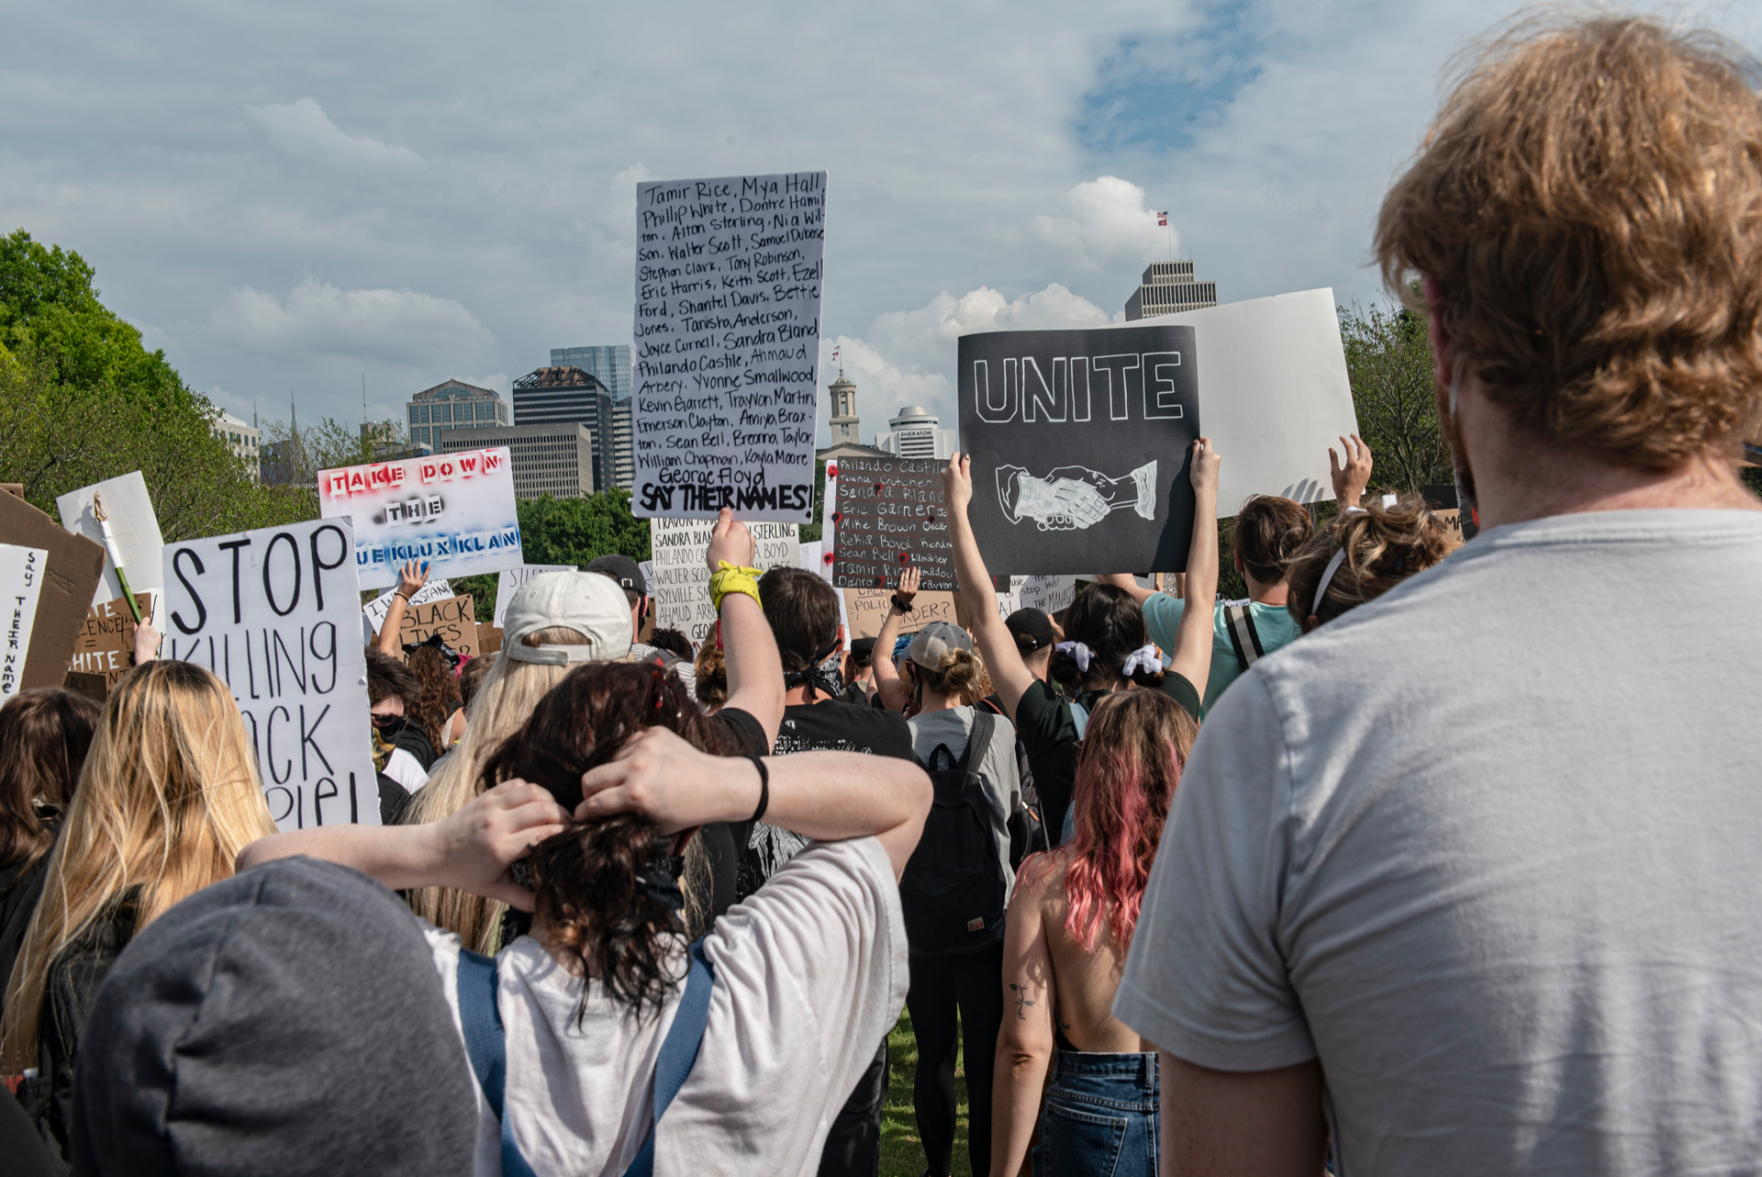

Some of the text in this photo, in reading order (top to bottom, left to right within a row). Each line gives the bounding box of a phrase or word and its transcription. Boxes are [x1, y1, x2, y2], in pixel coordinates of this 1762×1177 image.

[645, 173, 825, 206] Tamir Rice, Mya Hall,
[642, 205, 687, 228] Phillip
[690, 200, 735, 218] White,
[739, 198, 785, 213] Dontre
[672, 224, 706, 241] Alton
[773, 214, 799, 228] Nia
[804, 208, 825, 224] Wil-
[668, 242, 705, 260] Walter
[709, 234, 749, 255] Scott,
[751, 233, 789, 249] Samuel
[685, 261, 721, 276] Clark,
[726, 255, 750, 273] Tony
[753, 249, 805, 267] Robinson,
[641, 259, 823, 300] Eric Harris, Keith Scott, Ezell
[639, 302, 674, 318] Ford,
[679, 295, 727, 315] Shantel
[773, 285, 820, 302] Bettie
[681, 315, 733, 333] Tanisha
[733, 309, 797, 329] Anderson,
[639, 318, 819, 358] Joyce Curnell, Sandra Bland,
[639, 344, 807, 377] Philando Castile, Ahmaud
[693, 373, 742, 391] Yvonne
[743, 366, 817, 386] Smallwood,
[974, 351, 1183, 423] UNITE
[639, 386, 817, 413] Kevin Garrett, Trayvon Martin,
[637, 417, 687, 434] Emerson
[666, 435, 698, 449] Sean
[702, 432, 729, 448] Bell,
[780, 427, 814, 448] Taylor,
[638, 448, 808, 469] William Chapman, Kayla Moore
[840, 460, 893, 472] Philando
[332, 455, 499, 490] TAKE DOWN
[659, 467, 765, 488] George Floyd
[388, 500, 441, 521] THE
[639, 483, 813, 518] SAY THEIR NAMES!
[843, 501, 935, 517] Eric Garner
[754, 522, 795, 540] STERLING
[841, 517, 916, 532] Mike Brown
[922, 522, 948, 531] Oscar
[356, 531, 518, 565] UE KLUX KLAN
[655, 532, 691, 547] SANDRA
[764, 542, 788, 558] BOYD
[655, 548, 694, 566] PHILANDO
[839, 547, 894, 562] Sean Bell
[170, 524, 347, 636] STOP
[655, 568, 689, 585] WALTER
[838, 562, 905, 576] Tamir Ric
[920, 566, 952, 578] madou
[658, 586, 694, 604] SYLVILLE
[1021, 586, 1040, 595] stop
[8, 596, 26, 649] THEIR
[401, 599, 470, 630] BLACK
[659, 605, 691, 623] AHMUD
[399, 624, 462, 647] LIVES
[68, 650, 119, 671] HITE
